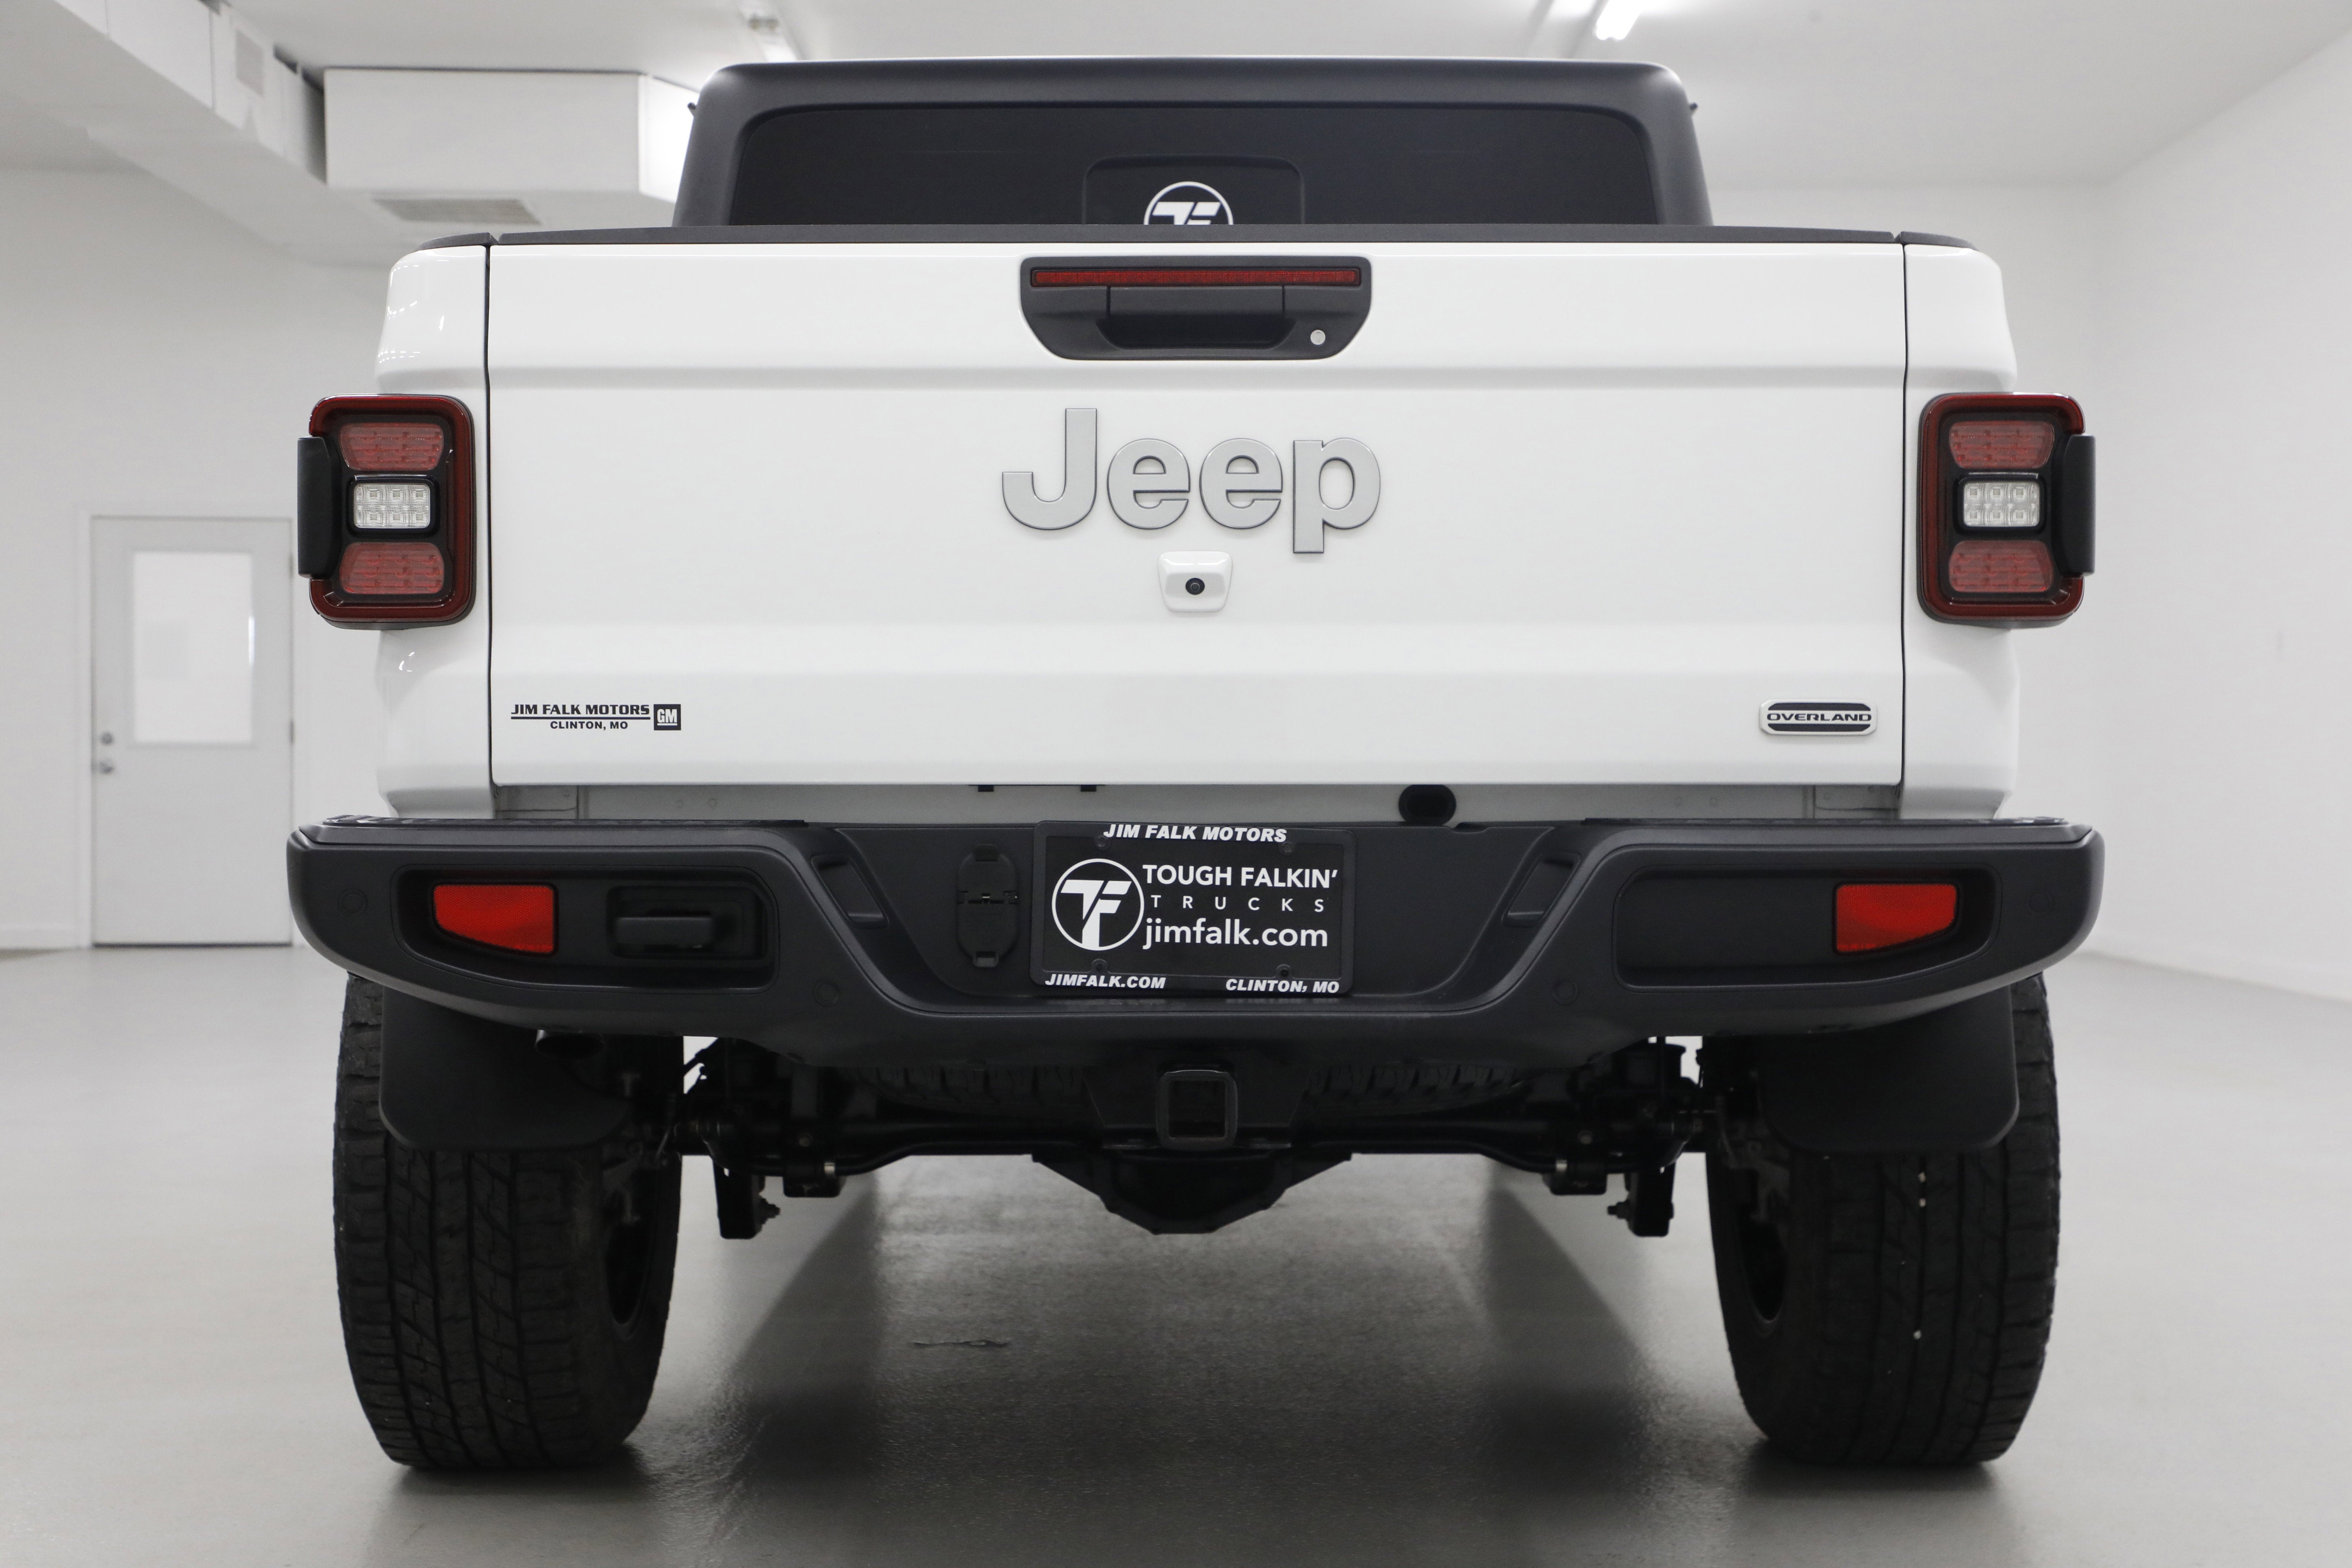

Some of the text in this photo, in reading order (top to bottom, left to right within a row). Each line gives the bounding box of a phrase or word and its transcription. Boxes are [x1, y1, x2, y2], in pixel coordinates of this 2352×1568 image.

[1002, 408, 1381, 554] Jeep
[511, 704, 650, 715] JIM FALK MOTORS
[657, 708, 677, 723] GM
[550, 721, 628, 731] CLINTON, MO
[1103, 824, 1287, 842] JIM FALK MOTORS
[1143, 864, 1338, 888] TOUGH FALKIN'
[1143, 918, 1327, 950] jimfalk.com
[1045, 973, 1166, 989] JIMFALK.COM
[1226, 978, 1339, 993] CLINTON, MO
